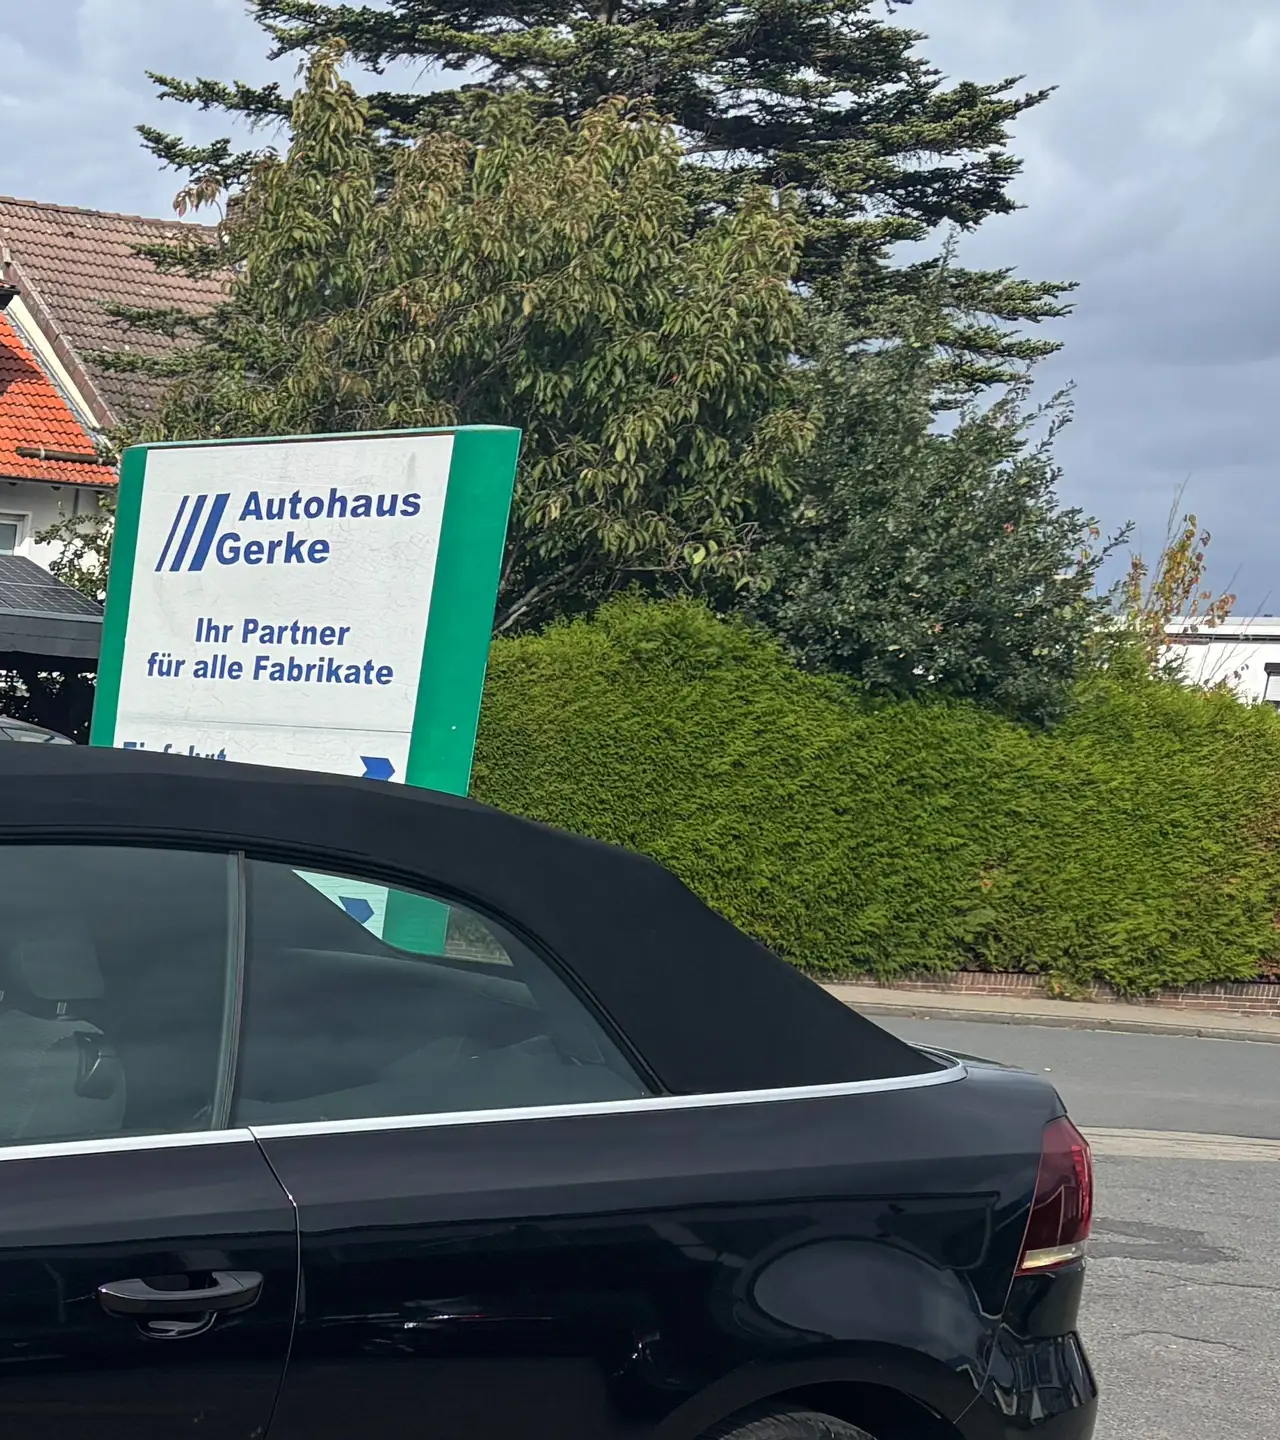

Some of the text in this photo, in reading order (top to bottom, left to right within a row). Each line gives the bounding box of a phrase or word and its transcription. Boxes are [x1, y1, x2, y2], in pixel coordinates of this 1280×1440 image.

[238, 487, 422, 522] Autohaus
[215, 531, 330, 565] Gerke
[195, 617, 351, 646] Ihr Partner
[147, 652, 394, 685] für alle Fabrikate
